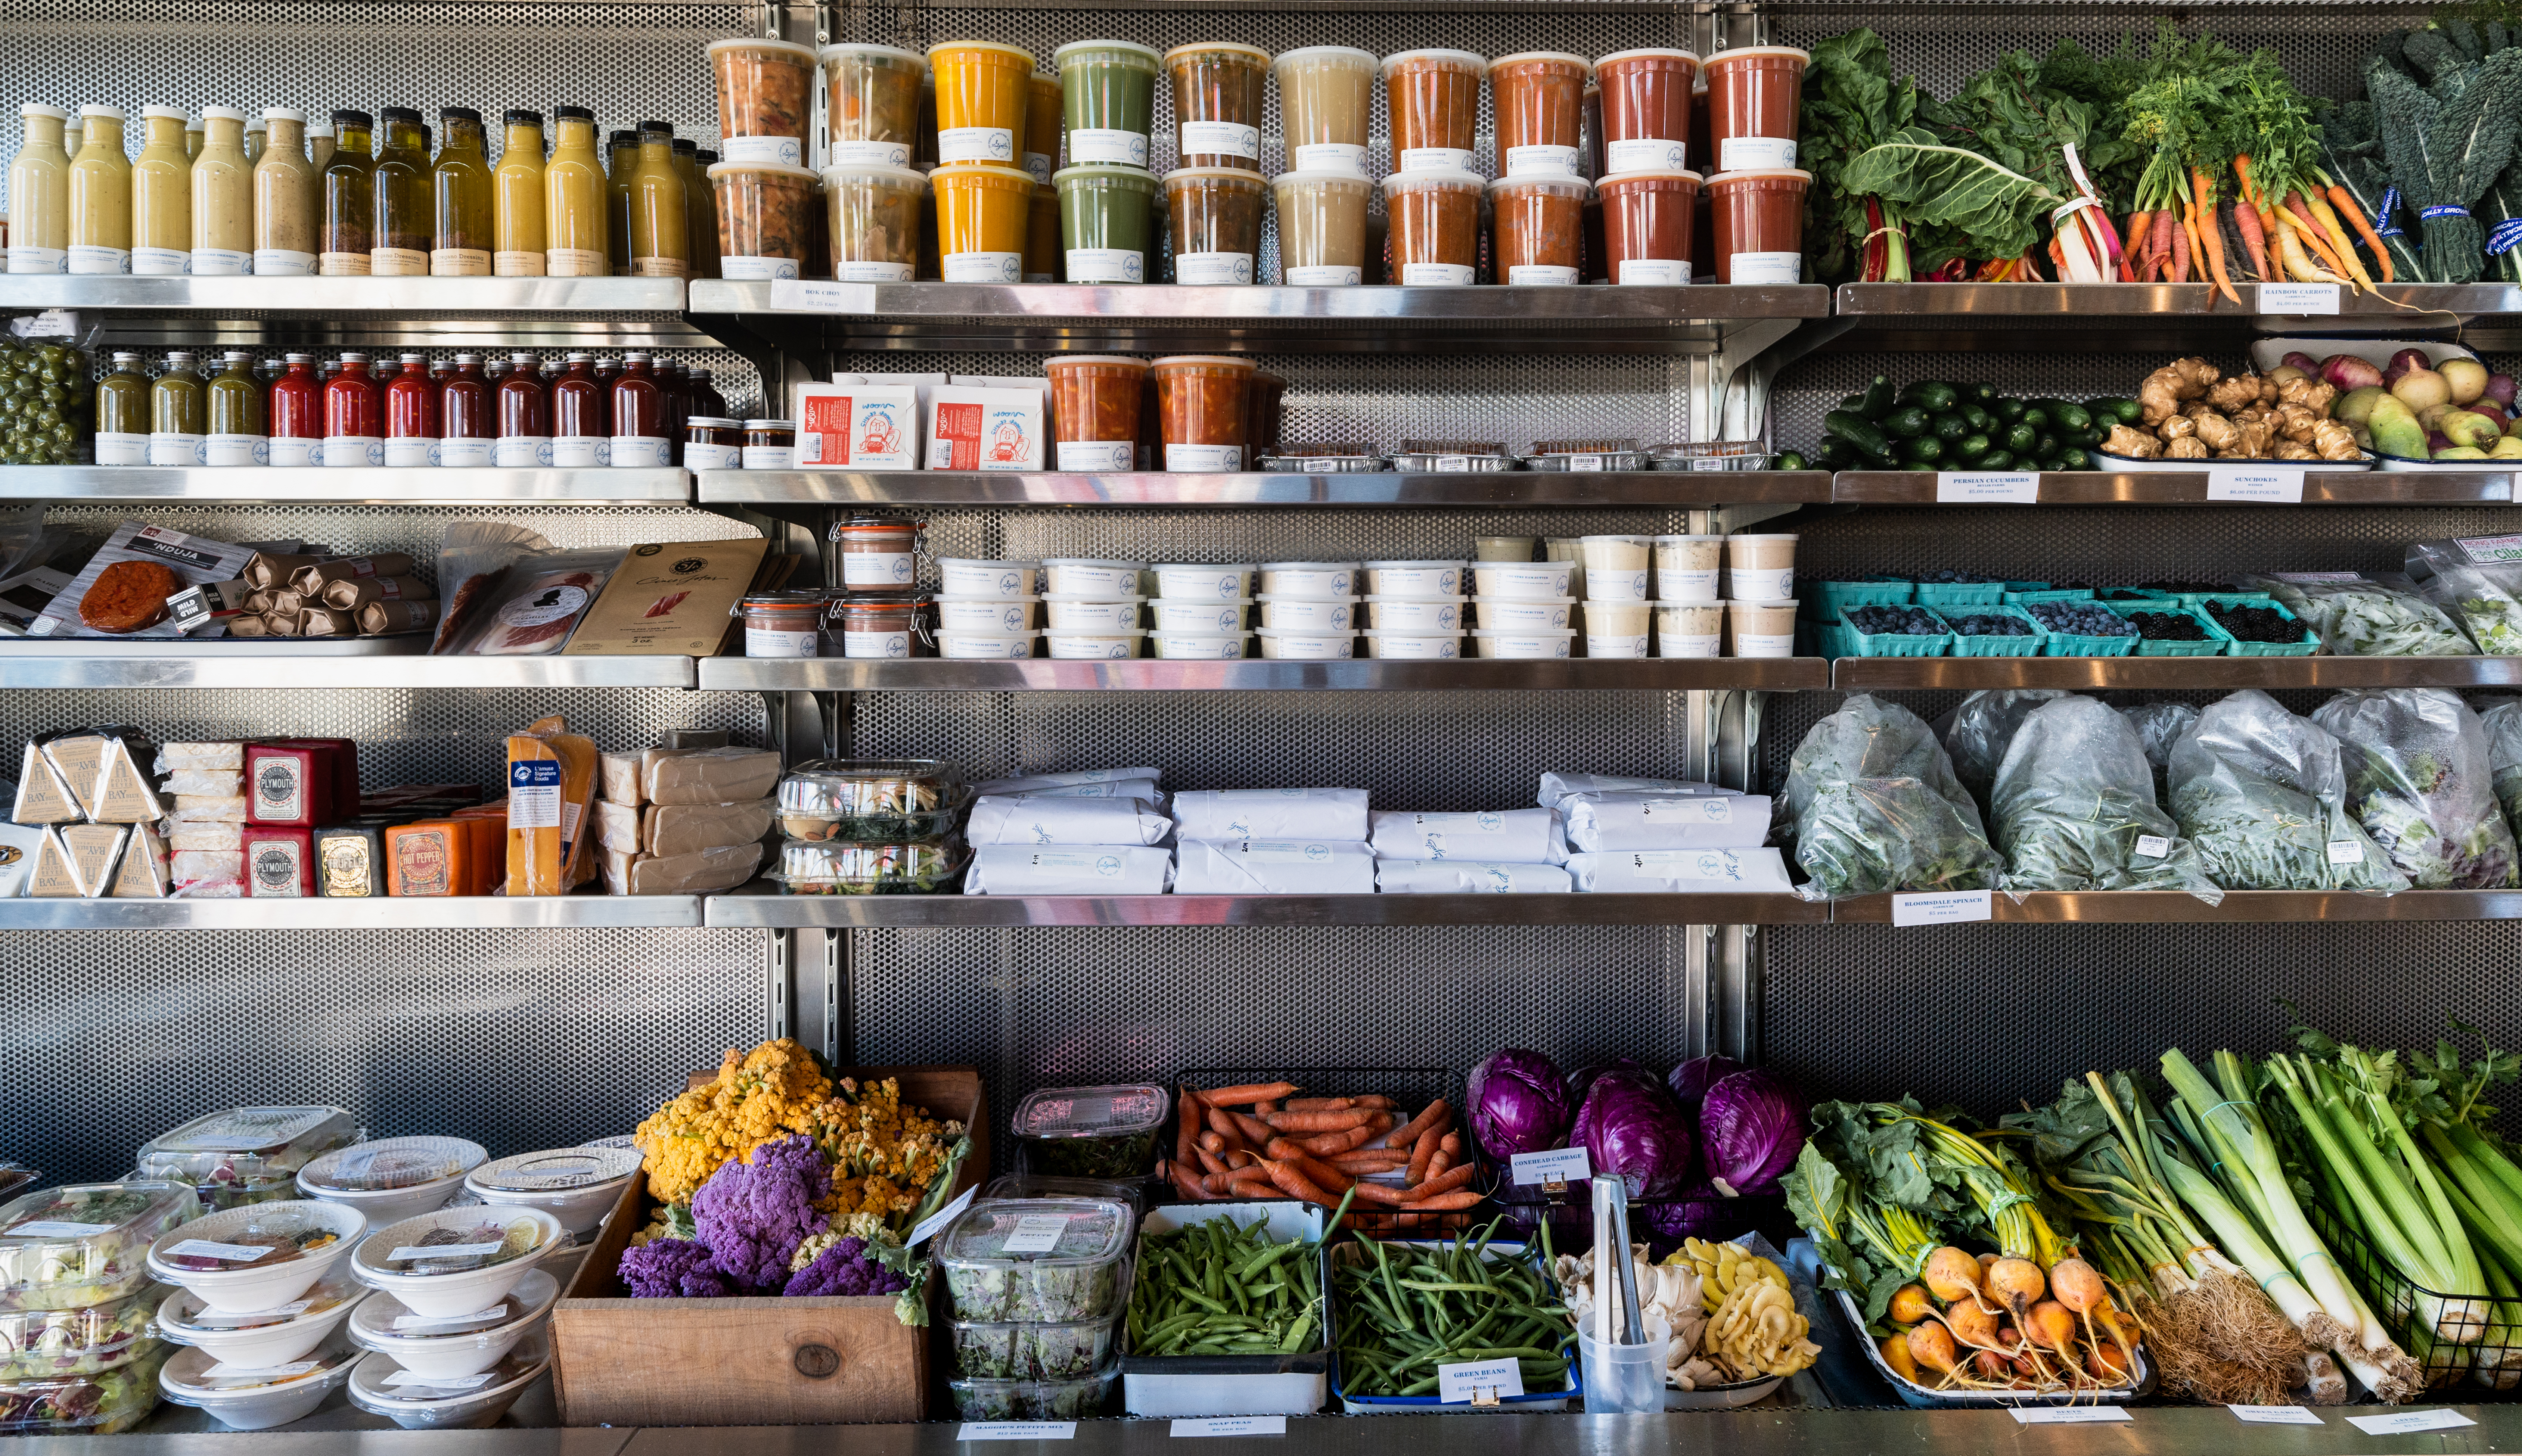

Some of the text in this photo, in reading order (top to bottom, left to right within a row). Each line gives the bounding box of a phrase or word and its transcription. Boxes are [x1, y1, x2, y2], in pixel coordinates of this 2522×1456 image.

[2444, 207, 2470, 215] GROWN
[394, 253, 420, 261] Dressing
[177, 599, 196, 611] MILD
[180, 605, 199, 618] MILD
[78, 760, 97, 770] BAY
[261, 778, 293, 788] PLYMOUTH
[27, 792, 46, 803] BAY
[108, 790, 127, 799] BAY
[263, 788, 292, 800] ARTISAN CHEESE
[409, 842, 432, 850] PLYMOUTH
[262, 852, 286, 860] ORIGINAL
[403, 850, 440, 865] HOT PEPPER
[257, 862, 292, 872] PLYMOUTH
[327, 857, 364, 869] TRUFFLE
[406, 863, 438, 877] ARTISAN CHEESE
[39, 877, 58, 887] BAY
[260, 872, 291, 884] ARTISAN CHEESE
[1514, 1153, 1582, 1167] CONEHEAD CABBAGE
[1481, 1368, 1506, 1376] BEANS
